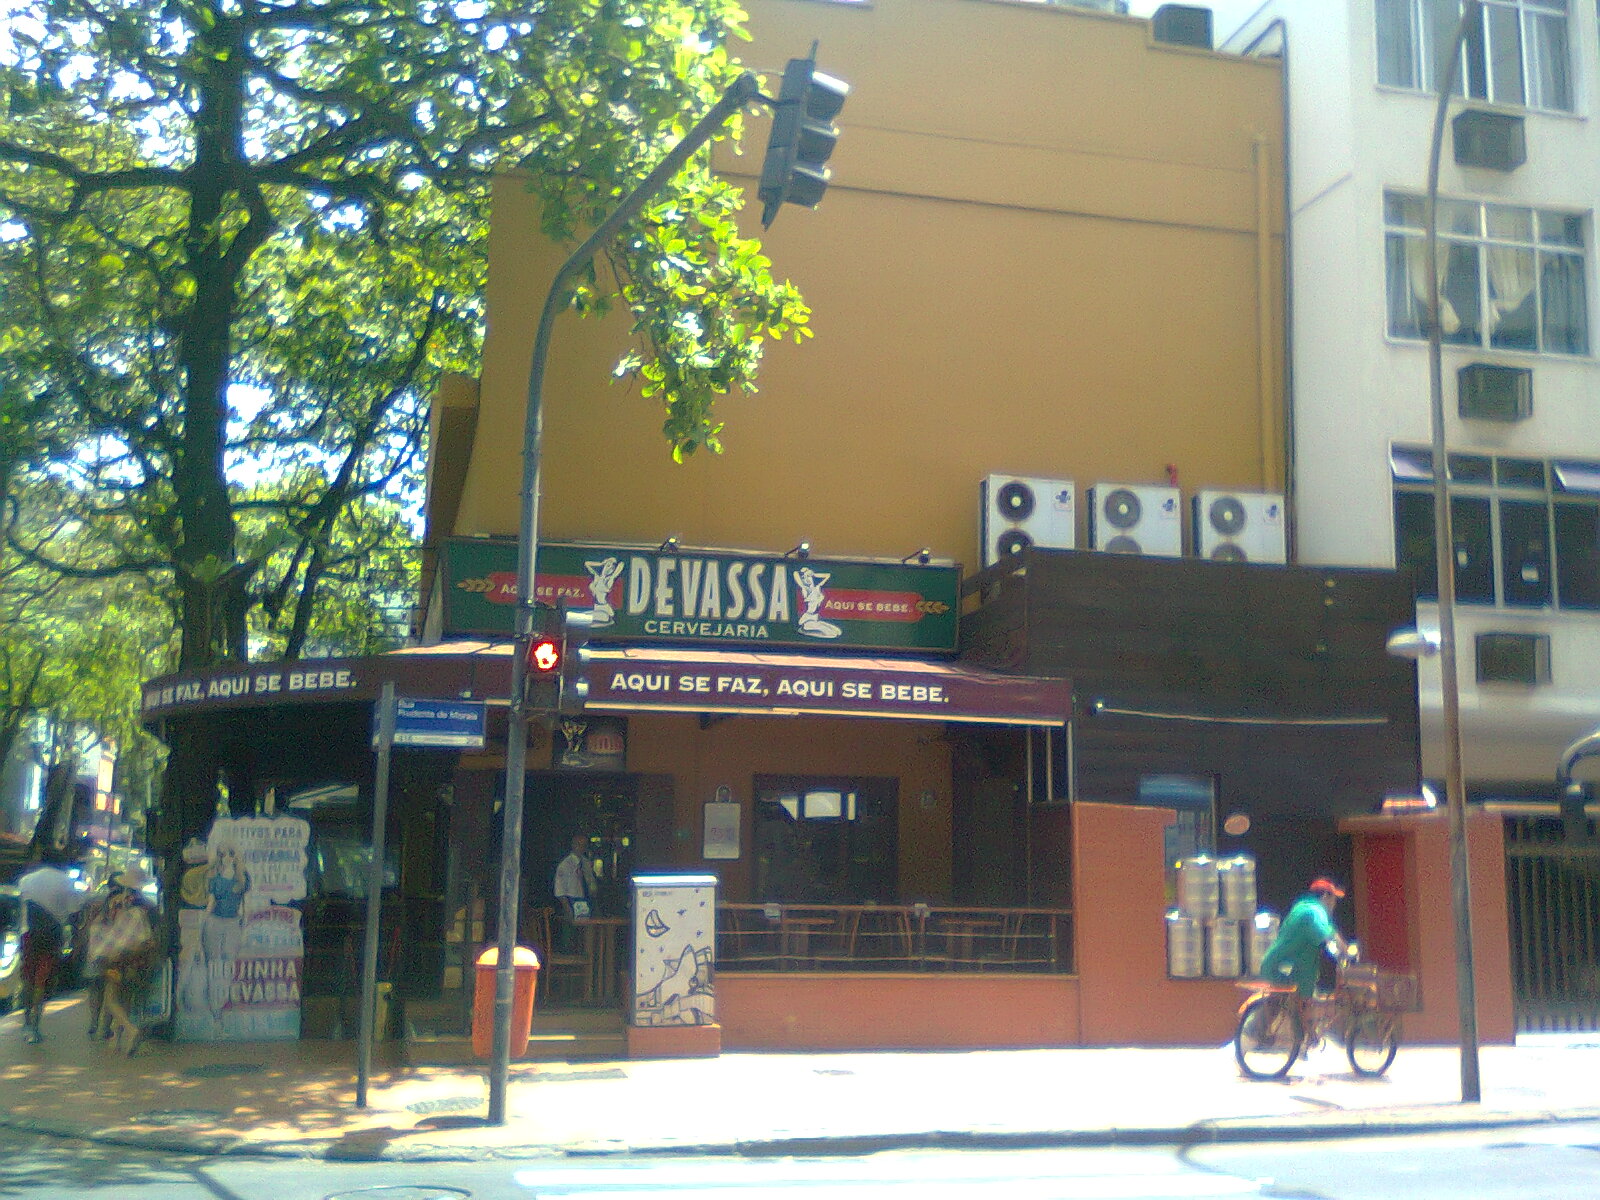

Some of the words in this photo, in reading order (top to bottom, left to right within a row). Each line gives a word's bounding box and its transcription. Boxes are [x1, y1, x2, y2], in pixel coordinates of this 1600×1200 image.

[537, 586, 553, 596] SE
[629, 557, 789, 621] DEVASSA
[825, 600, 854, 610] AQUI
[857, 602, 873, 611] SE
[876, 603, 912, 613] BEBE.
[644, 621, 769, 638] CERVEJARIA
[208, 677, 250, 698] AQUI
[254, 674, 282, 693] SE
[289, 671, 358, 690] BEBE.
[610, 673, 671, 692] AQUI
[679, 675, 711, 692] SE
[717, 676, 769, 697] FAZ,
[776, 679, 833, 698] AQUI
[842, 682, 872, 699] SE
[881, 684, 949, 703] BEBE.
